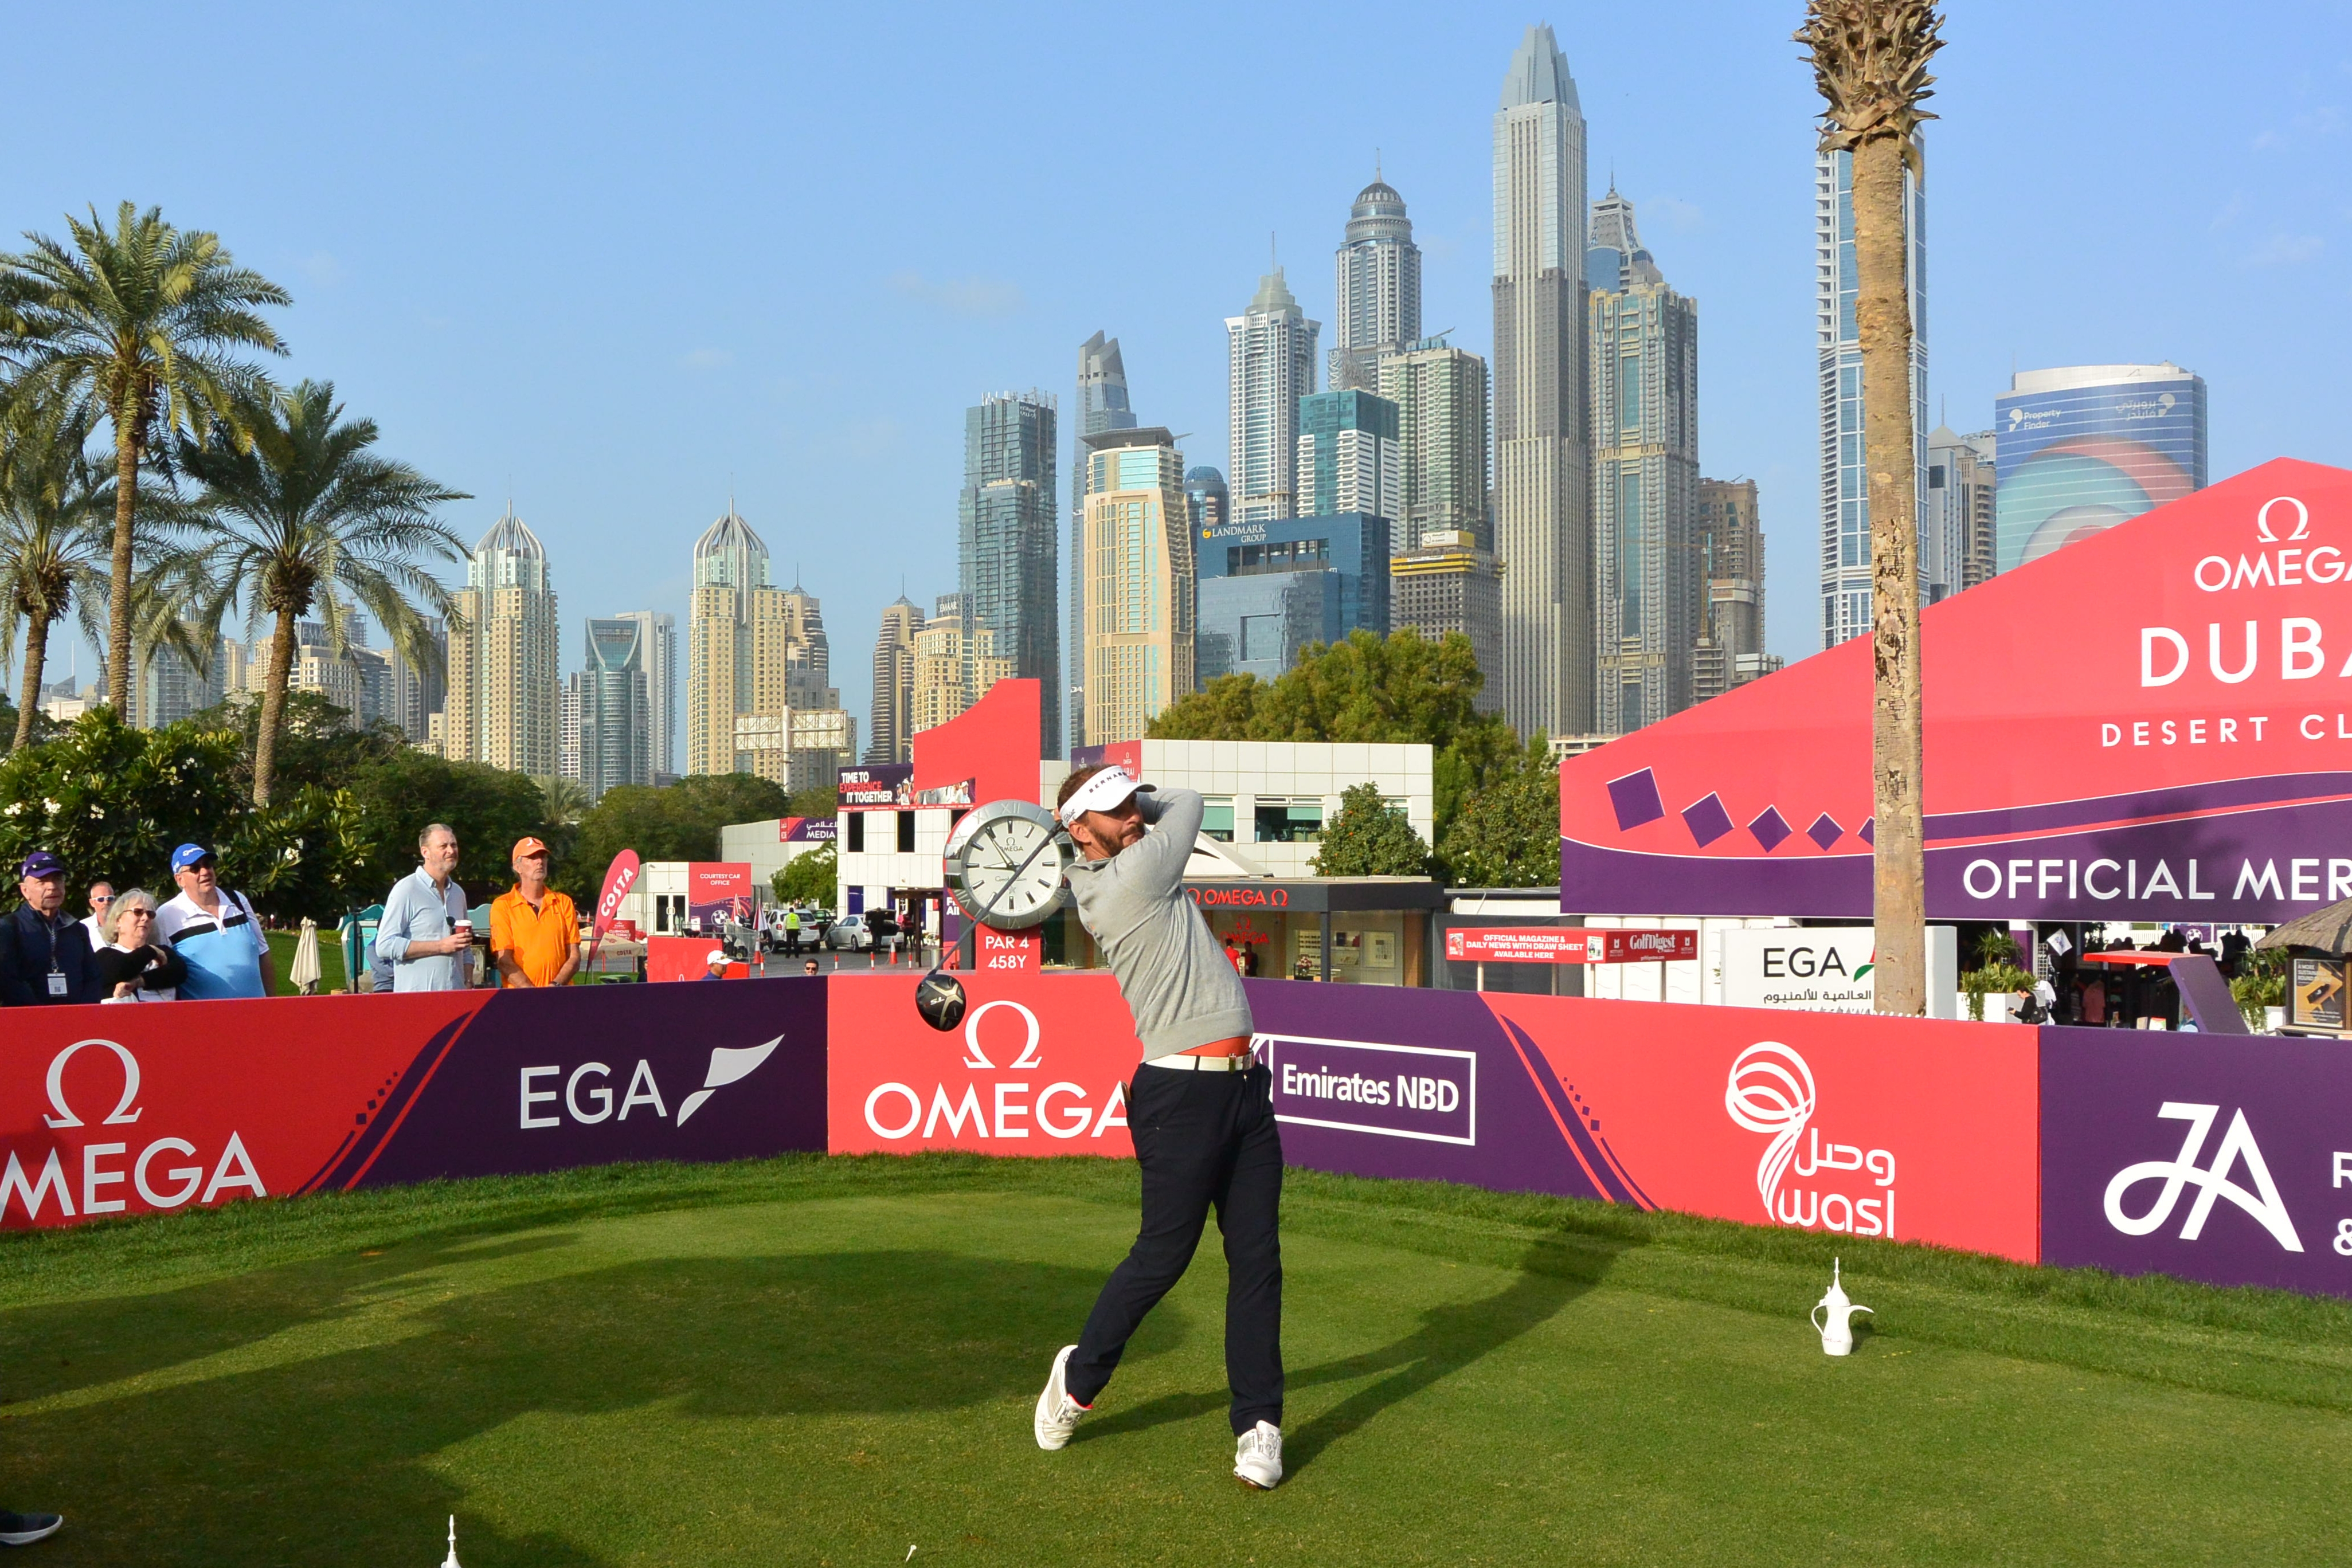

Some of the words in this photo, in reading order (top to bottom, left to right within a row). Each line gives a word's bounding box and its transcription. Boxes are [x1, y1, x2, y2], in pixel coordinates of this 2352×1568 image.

[2024, 410, 2061, 420] Property
[2024, 421, 2050, 430] Finder
[1212, 524, 1266, 537] LANDMARK
[1241, 534, 1266, 543] GROUP
[2194, 546, 2352, 591] OMEG
[2102, 717, 2268, 747] DESERT
[842, 772, 858, 783] TIME
[859, 771, 869, 782] TO
[839, 781, 882, 793] EXPERIENCE
[847, 792, 853, 803] IT
[854, 791, 893, 803] TOGETHER
[806, 830, 835, 838] MEDIA
[1963, 859, 2215, 899] OFFICIAL
[601, 868, 633, 916] COSTA
[1205, 889, 1266, 905] OMEGA
[946, 906, 960, 915] All
[985, 936, 1013, 950] PAR
[1019, 936, 1030, 949] 4
[1219, 931, 1270, 944] OMEGA
[1630, 934, 1676, 950] GolfDigest
[988, 955, 1027, 969] 458Y
[1764, 947, 1848, 978] EGA
[1764, 988, 1818, 1003] للألمنيوم
[1823, 990, 1871, 1002] العالمية
[521, 1060, 667, 1129] EGA
[1283, 1064, 1391, 1106] Emirates
[1397, 1075, 1459, 1112] NBD
[864, 1080, 1127, 1139] OMEGA
[1794, 1127, 1896, 1186] وصل
[1778, 1188, 1895, 1239] wasl
